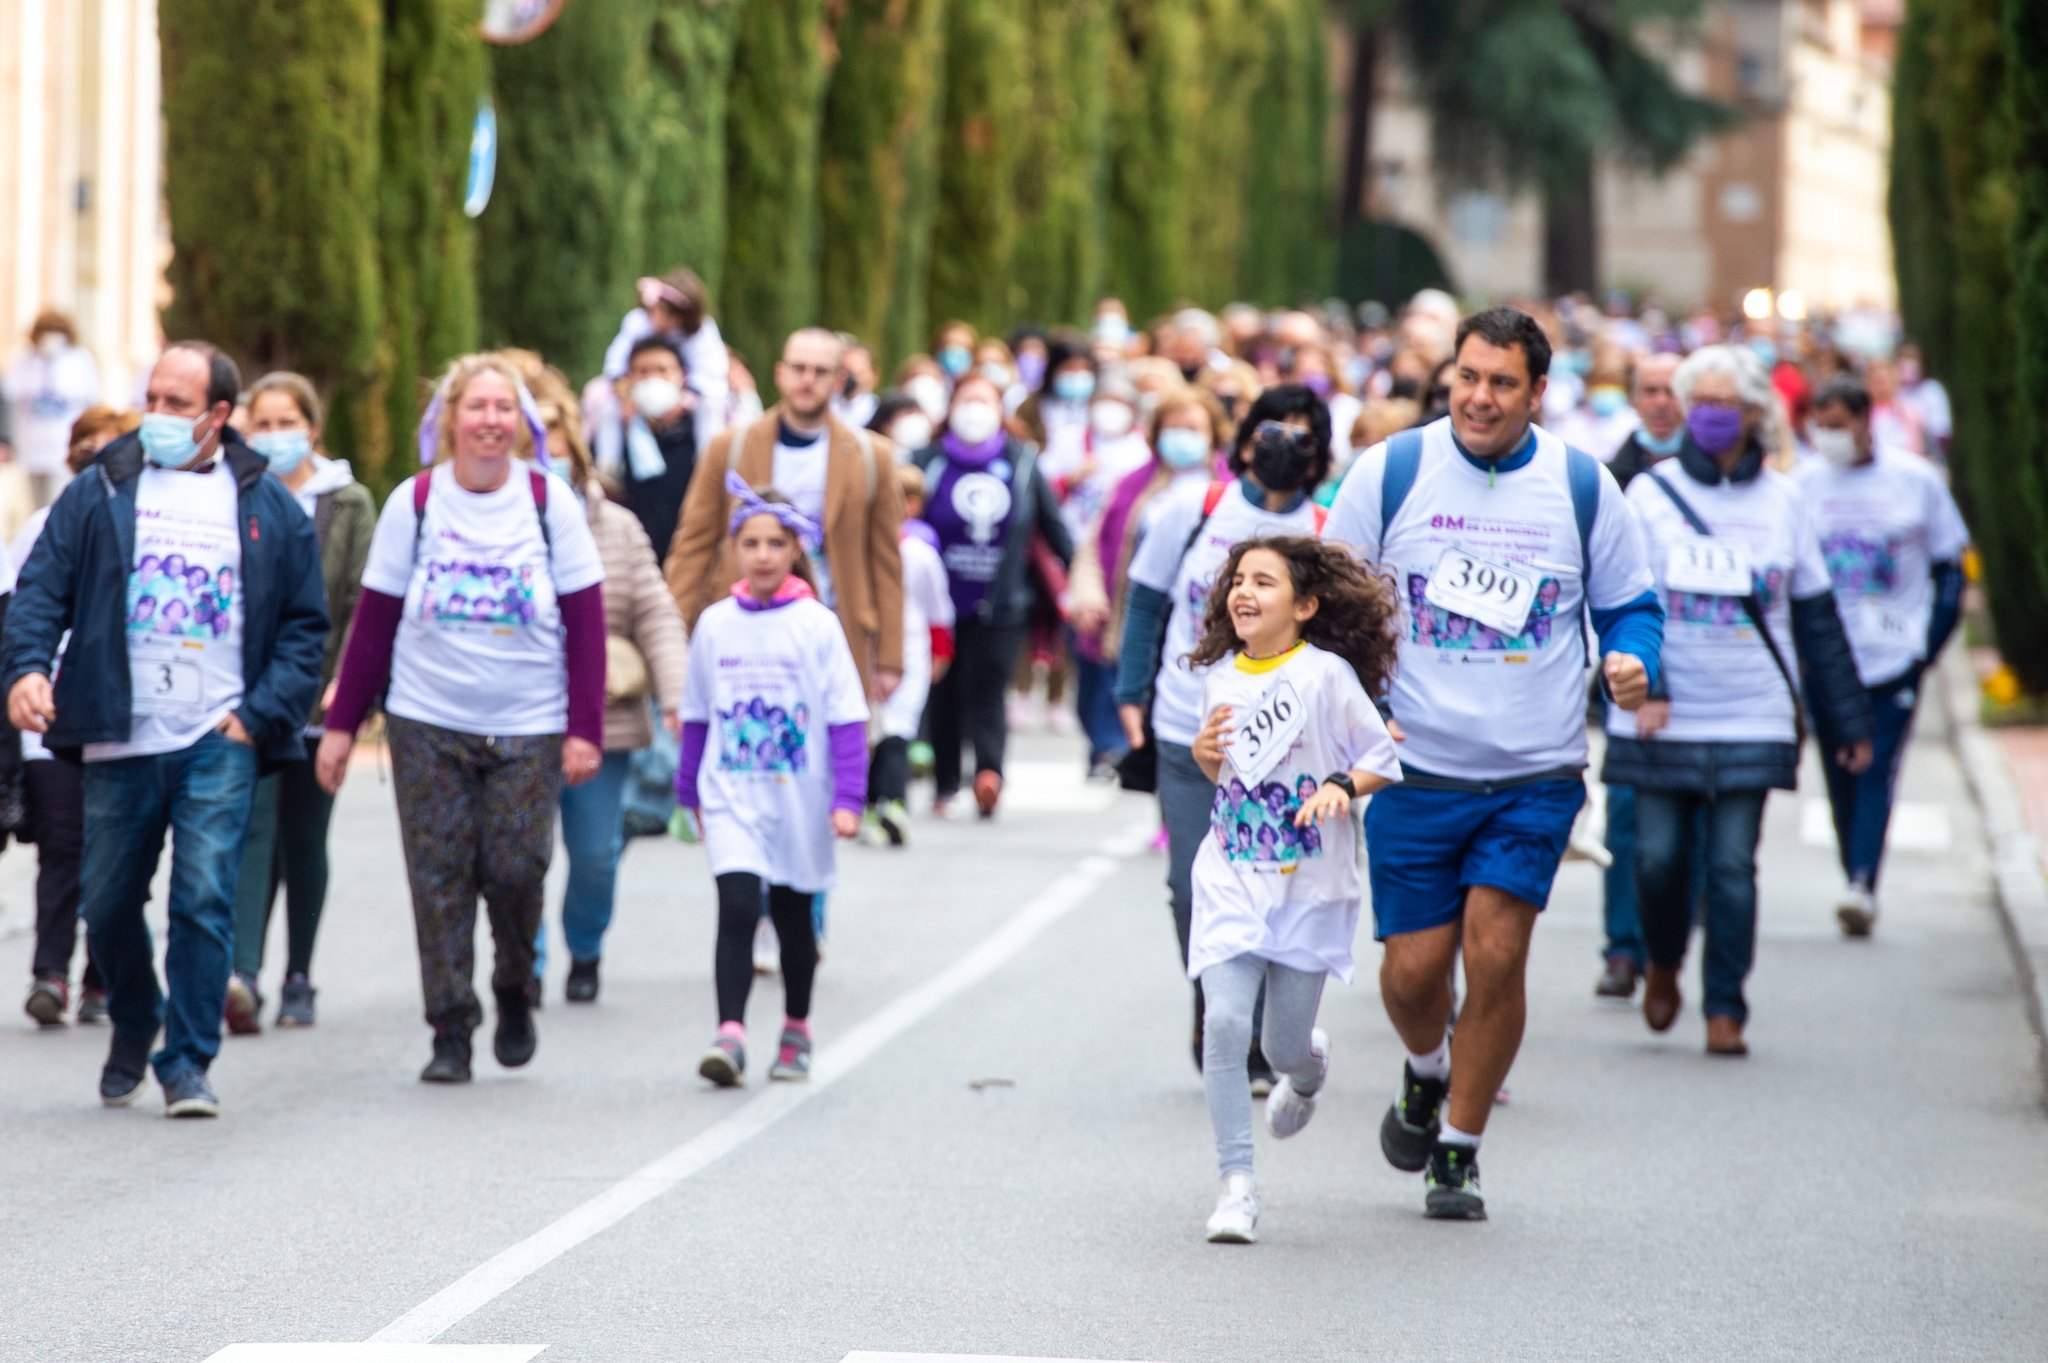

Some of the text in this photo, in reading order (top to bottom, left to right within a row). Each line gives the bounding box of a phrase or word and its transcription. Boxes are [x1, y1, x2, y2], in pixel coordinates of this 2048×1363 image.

[1431, 514, 1465, 529] 8M
[1449, 558, 1519, 603] 399
[155, 663, 173, 694] 3
[1240, 691, 1292, 758] 396
